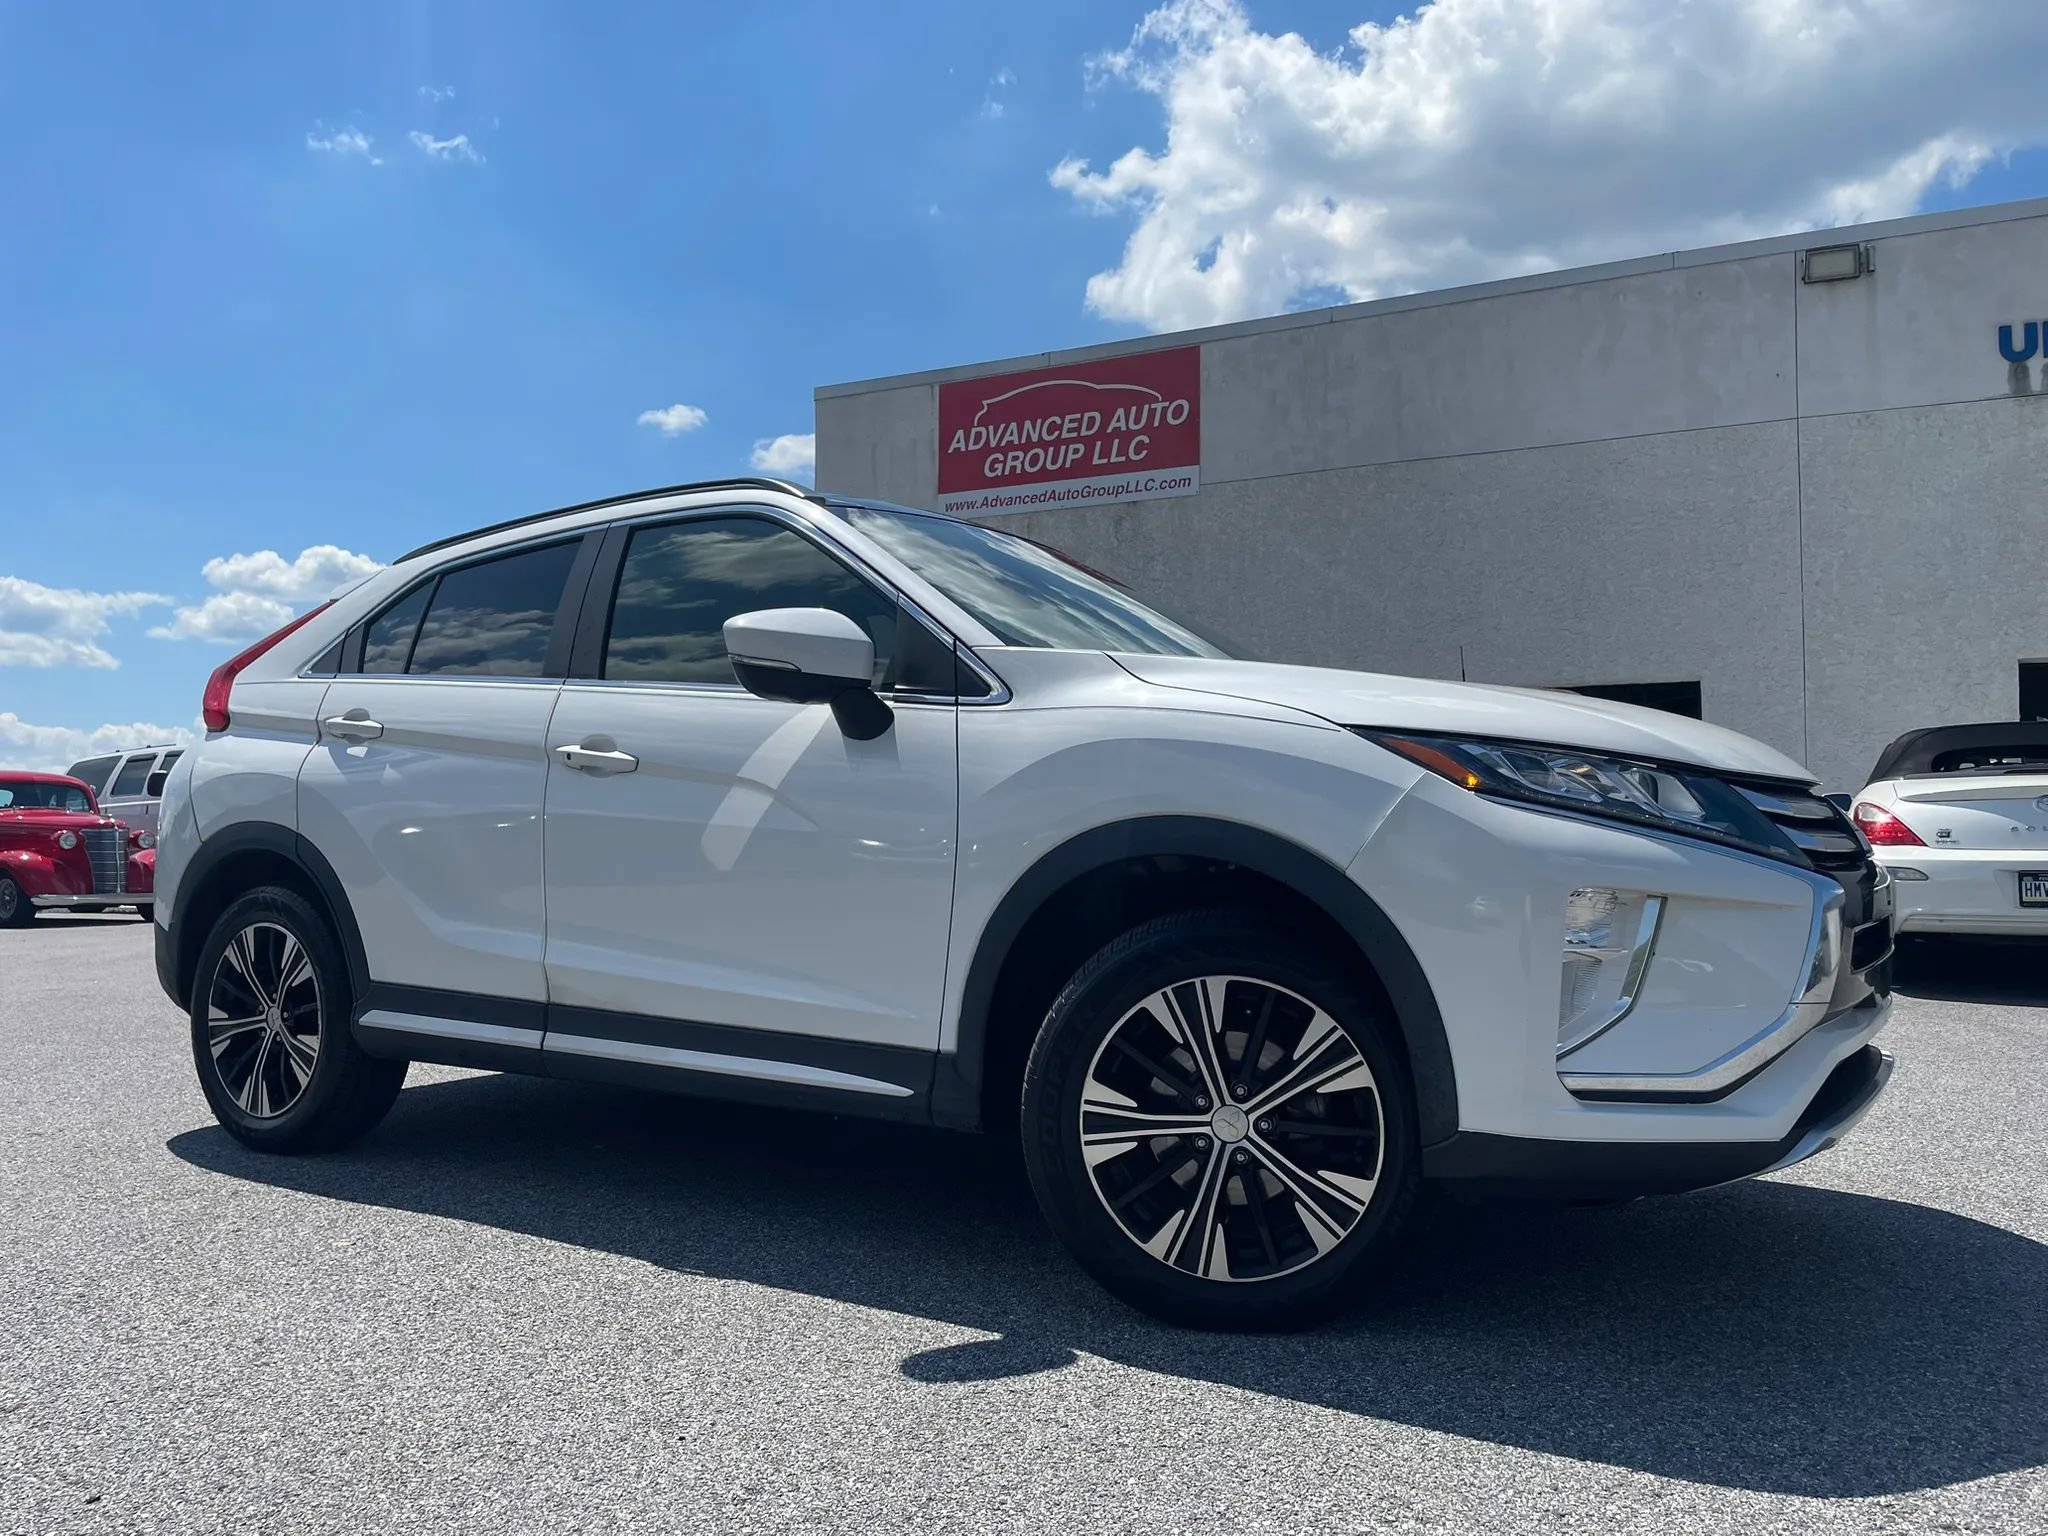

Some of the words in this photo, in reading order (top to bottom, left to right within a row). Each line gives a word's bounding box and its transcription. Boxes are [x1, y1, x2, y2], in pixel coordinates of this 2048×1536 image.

[1998, 320, 2048, 363] U
[948, 411, 1101, 453] ADVANCED
[1106, 399, 1190, 433] AUTO
[983, 446, 1085, 478] GROUP
[1092, 435, 1150, 465] LLC
[944, 475, 1192, 513] www.AdvancedAutoGroupLLC.com
